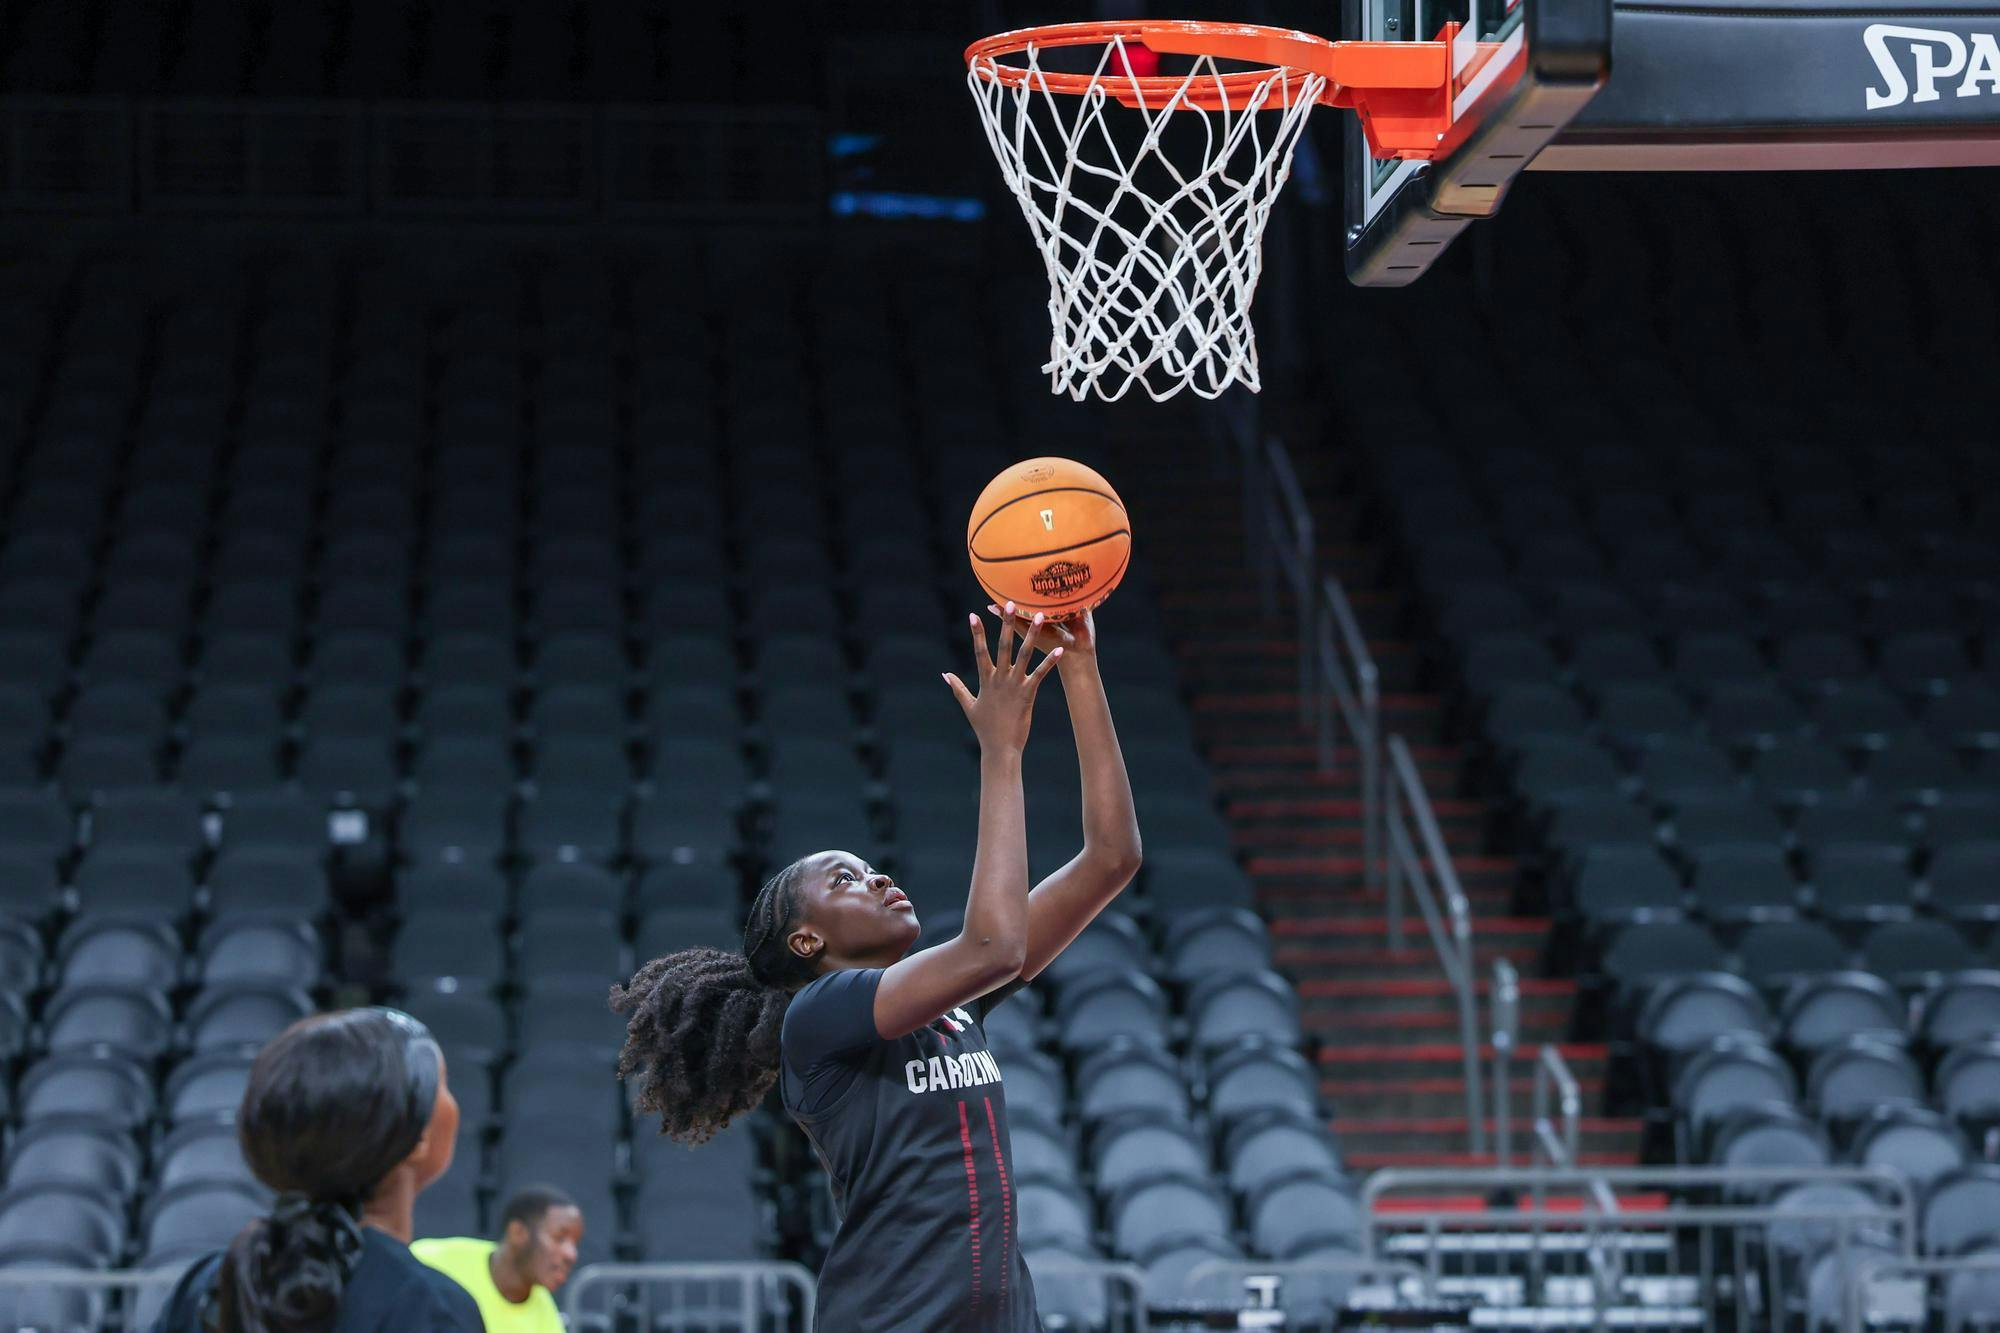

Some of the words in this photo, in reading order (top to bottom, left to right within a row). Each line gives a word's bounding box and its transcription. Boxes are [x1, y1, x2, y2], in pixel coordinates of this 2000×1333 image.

[1863, 24, 2000, 110] SPA
[1034, 577, 1062, 591] FOUR
[1063, 569, 1090, 587] FINAL
